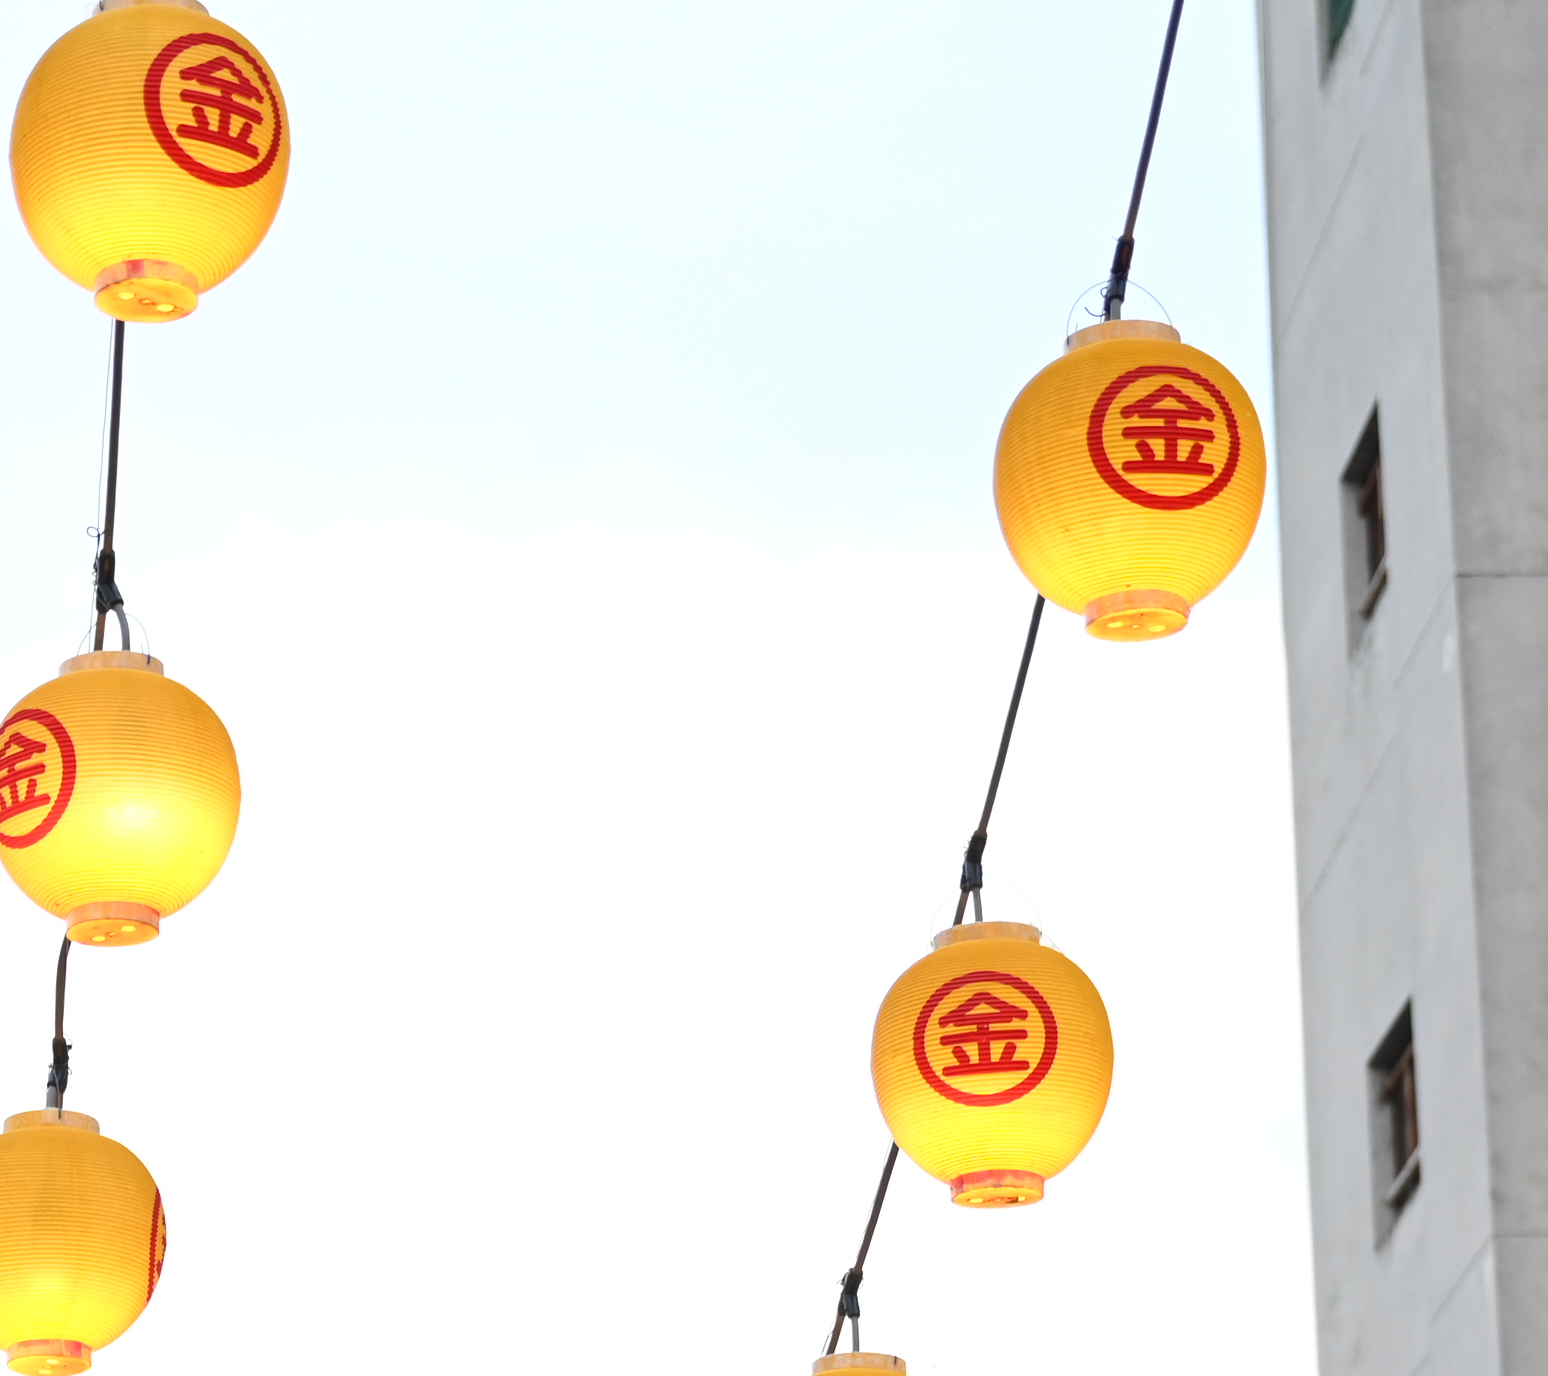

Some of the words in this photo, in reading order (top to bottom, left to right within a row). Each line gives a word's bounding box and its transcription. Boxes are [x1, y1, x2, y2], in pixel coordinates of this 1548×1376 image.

[176, 56, 265, 159] 金
[1120, 384, 1217, 476] 金
[939, 991, 1030, 1077] 金
